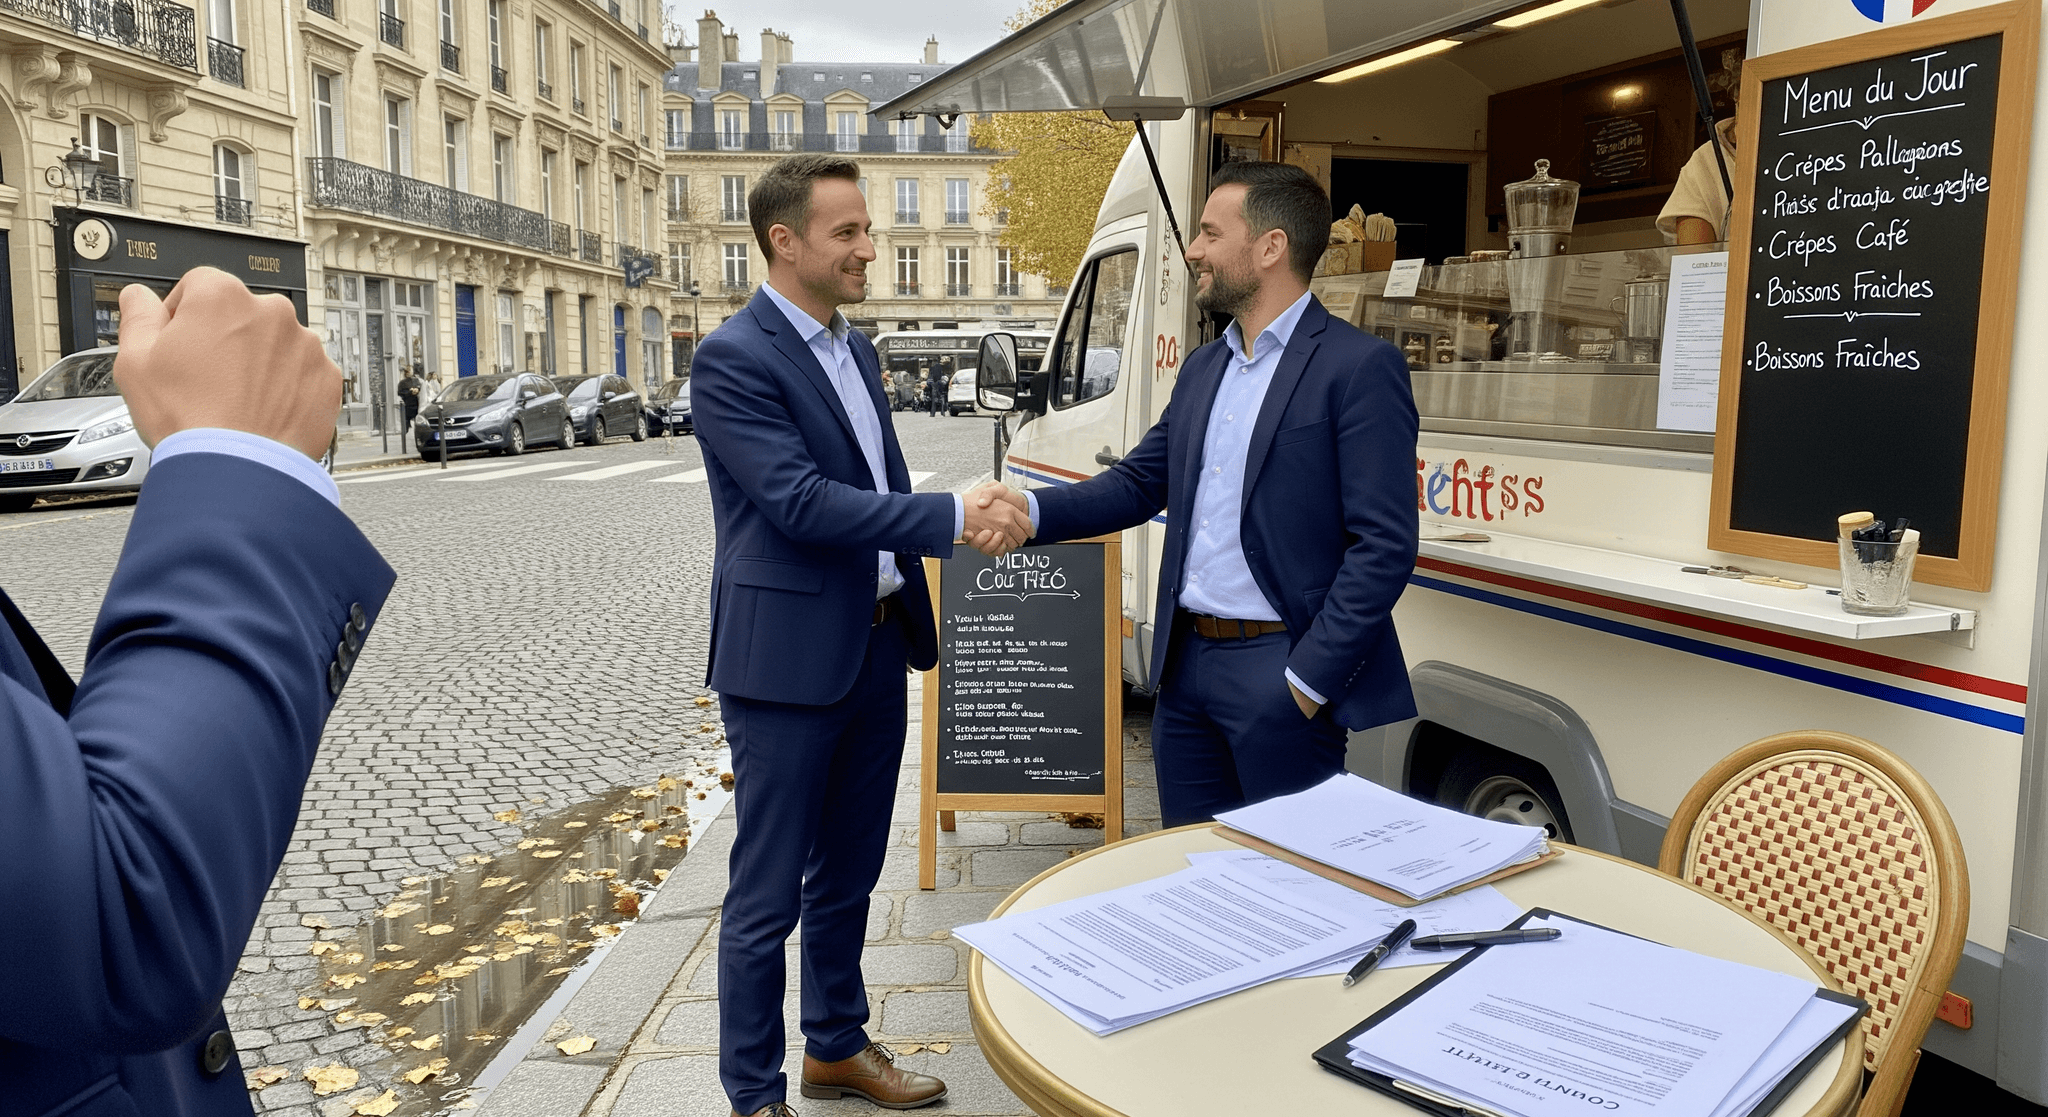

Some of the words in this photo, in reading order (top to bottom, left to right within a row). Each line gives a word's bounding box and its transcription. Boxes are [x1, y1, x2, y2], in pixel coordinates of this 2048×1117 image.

[1783, 77, 1852, 124] Menu
[1865, 67, 1894, 103] du
[1904, 50, 1978, 101] Jour
[1856, 218, 1910, 251] Café
[1767, 276, 1841, 307] Boissons
[1853, 269, 1934, 301] Fraiches
[1755, 341, 1824, 372] Boissons
[1835, 337, 1921, 371] Fraîches
